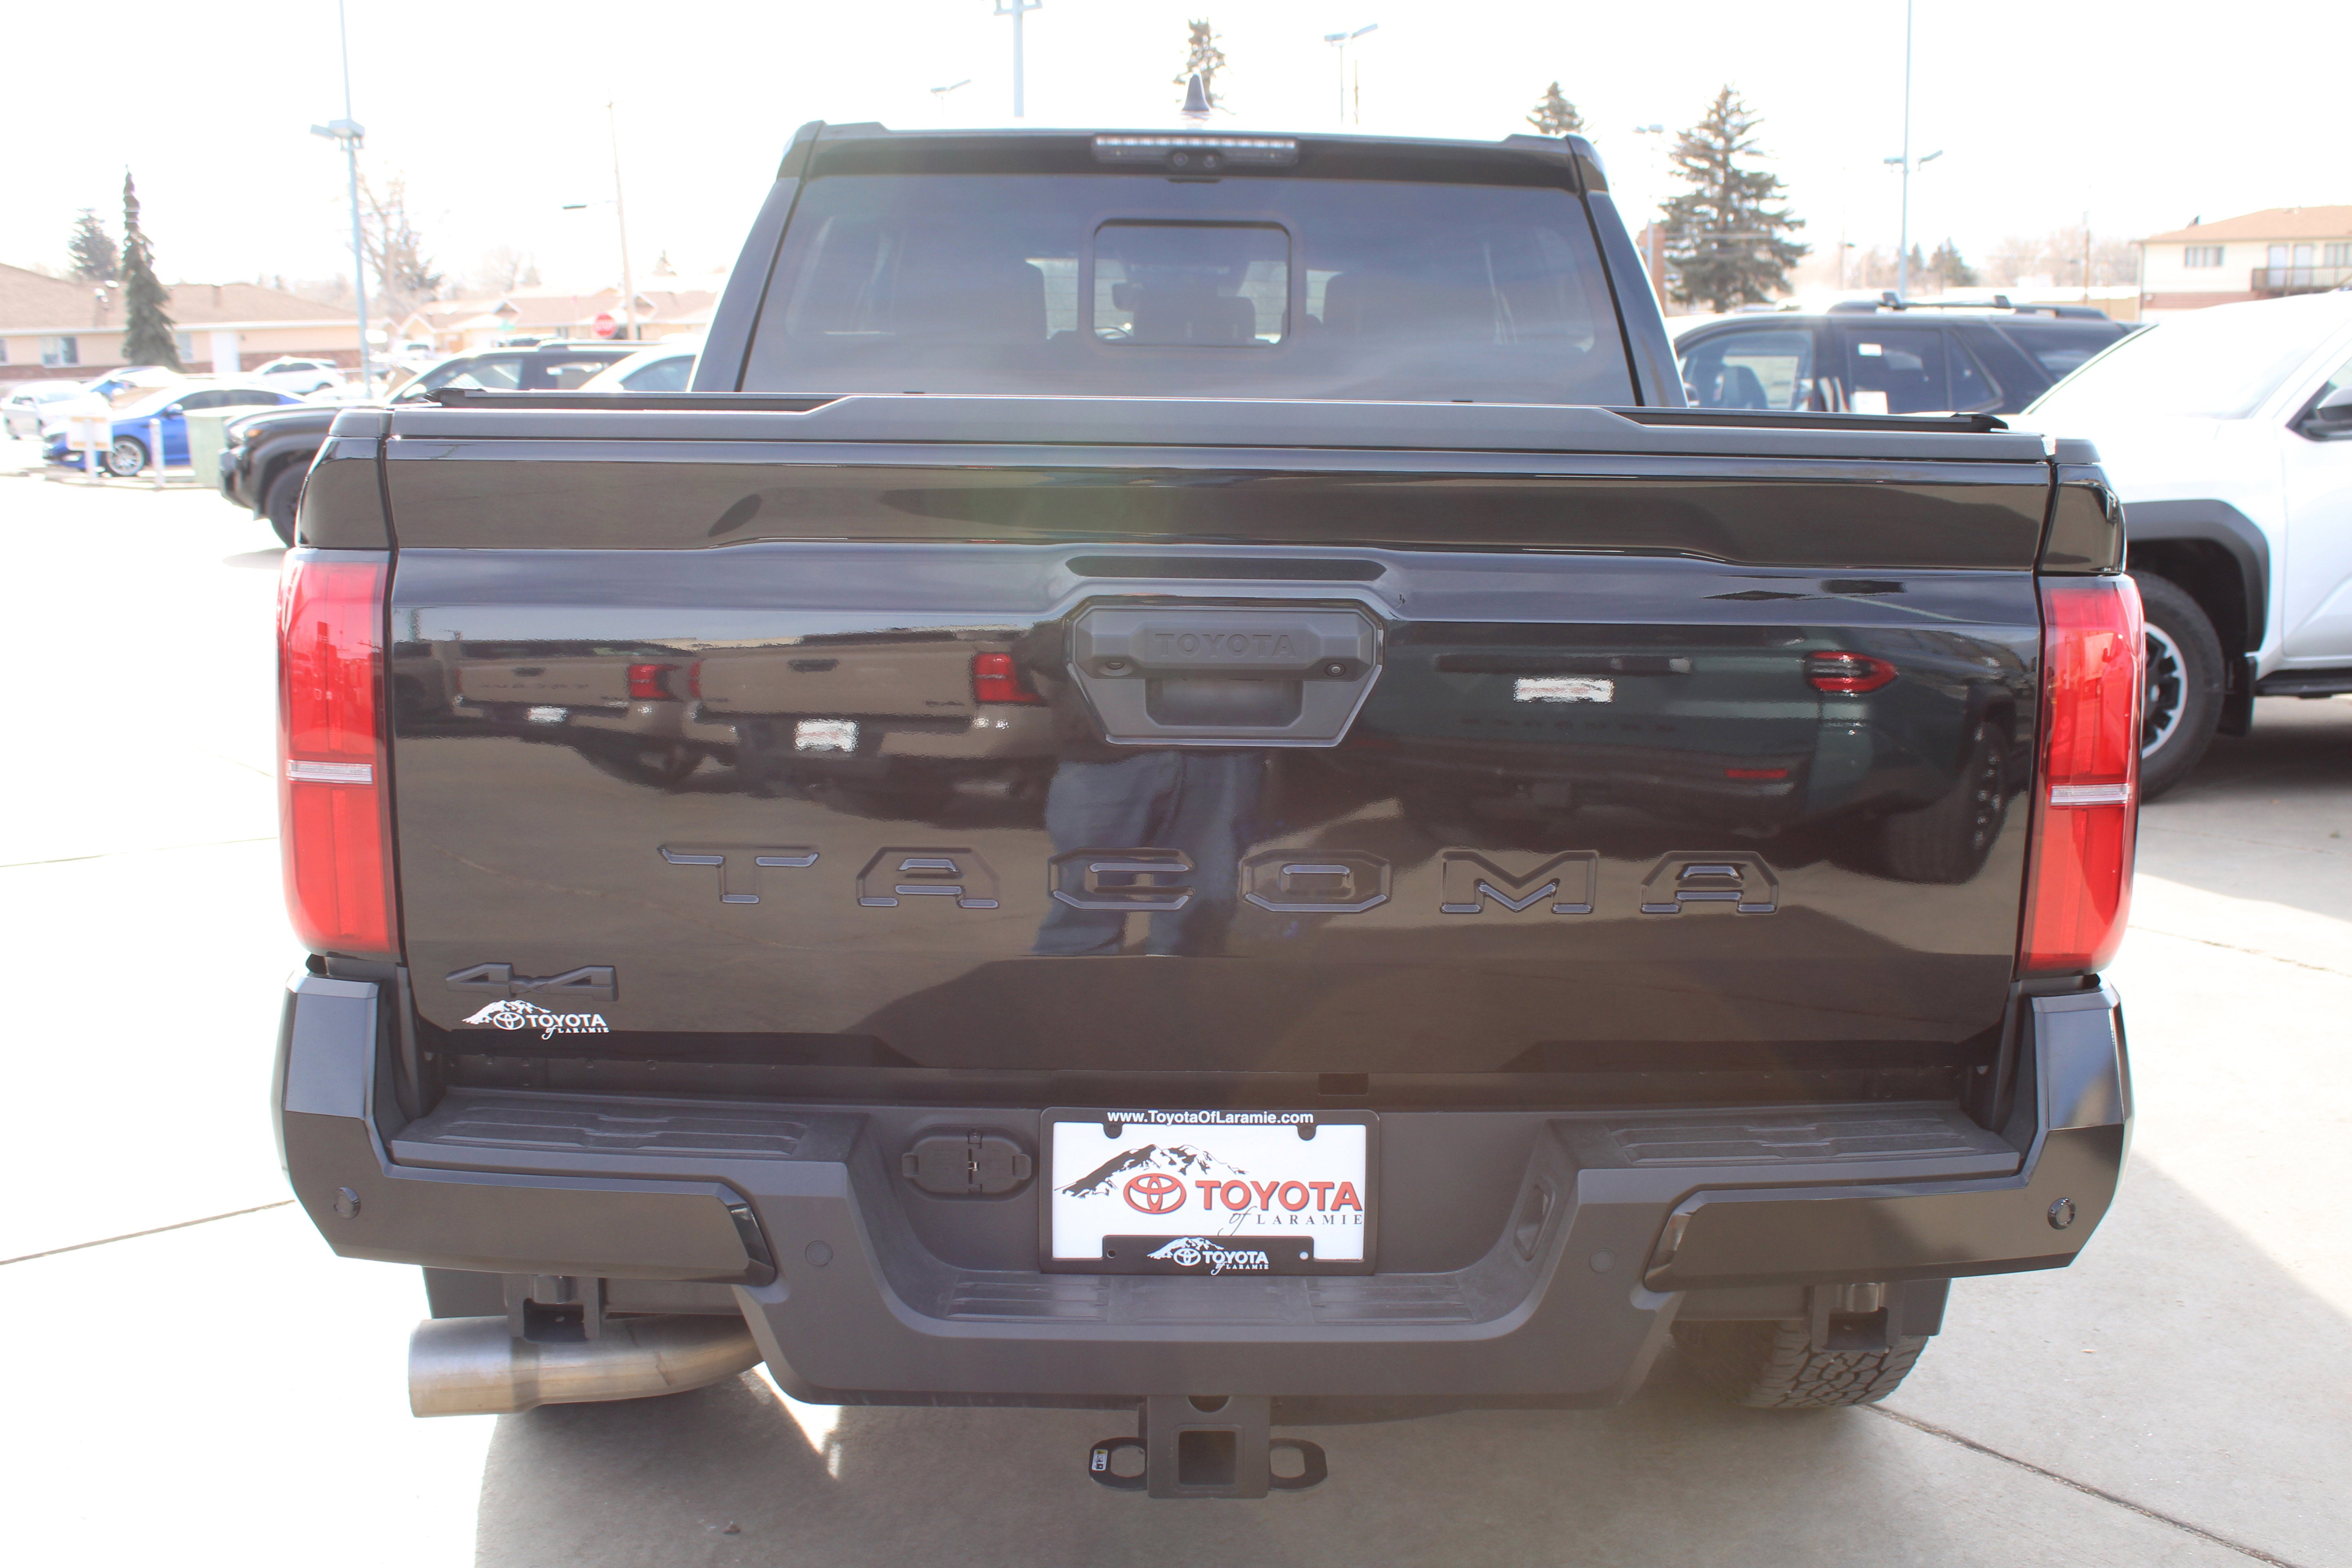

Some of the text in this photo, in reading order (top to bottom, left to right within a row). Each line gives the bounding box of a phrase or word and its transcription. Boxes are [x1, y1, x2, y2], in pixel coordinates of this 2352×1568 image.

[595, 321, 615, 330] STOP
[1154, 633, 1296, 658] TOYOTA
[657, 842, 1779, 914] TACOMA
[526, 1014, 607, 1027] TOYOTA
[541, 1025, 558, 1040] of
[1107, 1110, 1314, 1126] www.ToyotaOfLaramie.com
[1195, 1180, 1363, 1212] TOYOTA
[1218, 1206, 1363, 1236] of LARAMIE
[1202, 1251, 1269, 1264] TOYOTA
[1210, 1261, 1227, 1276] of
